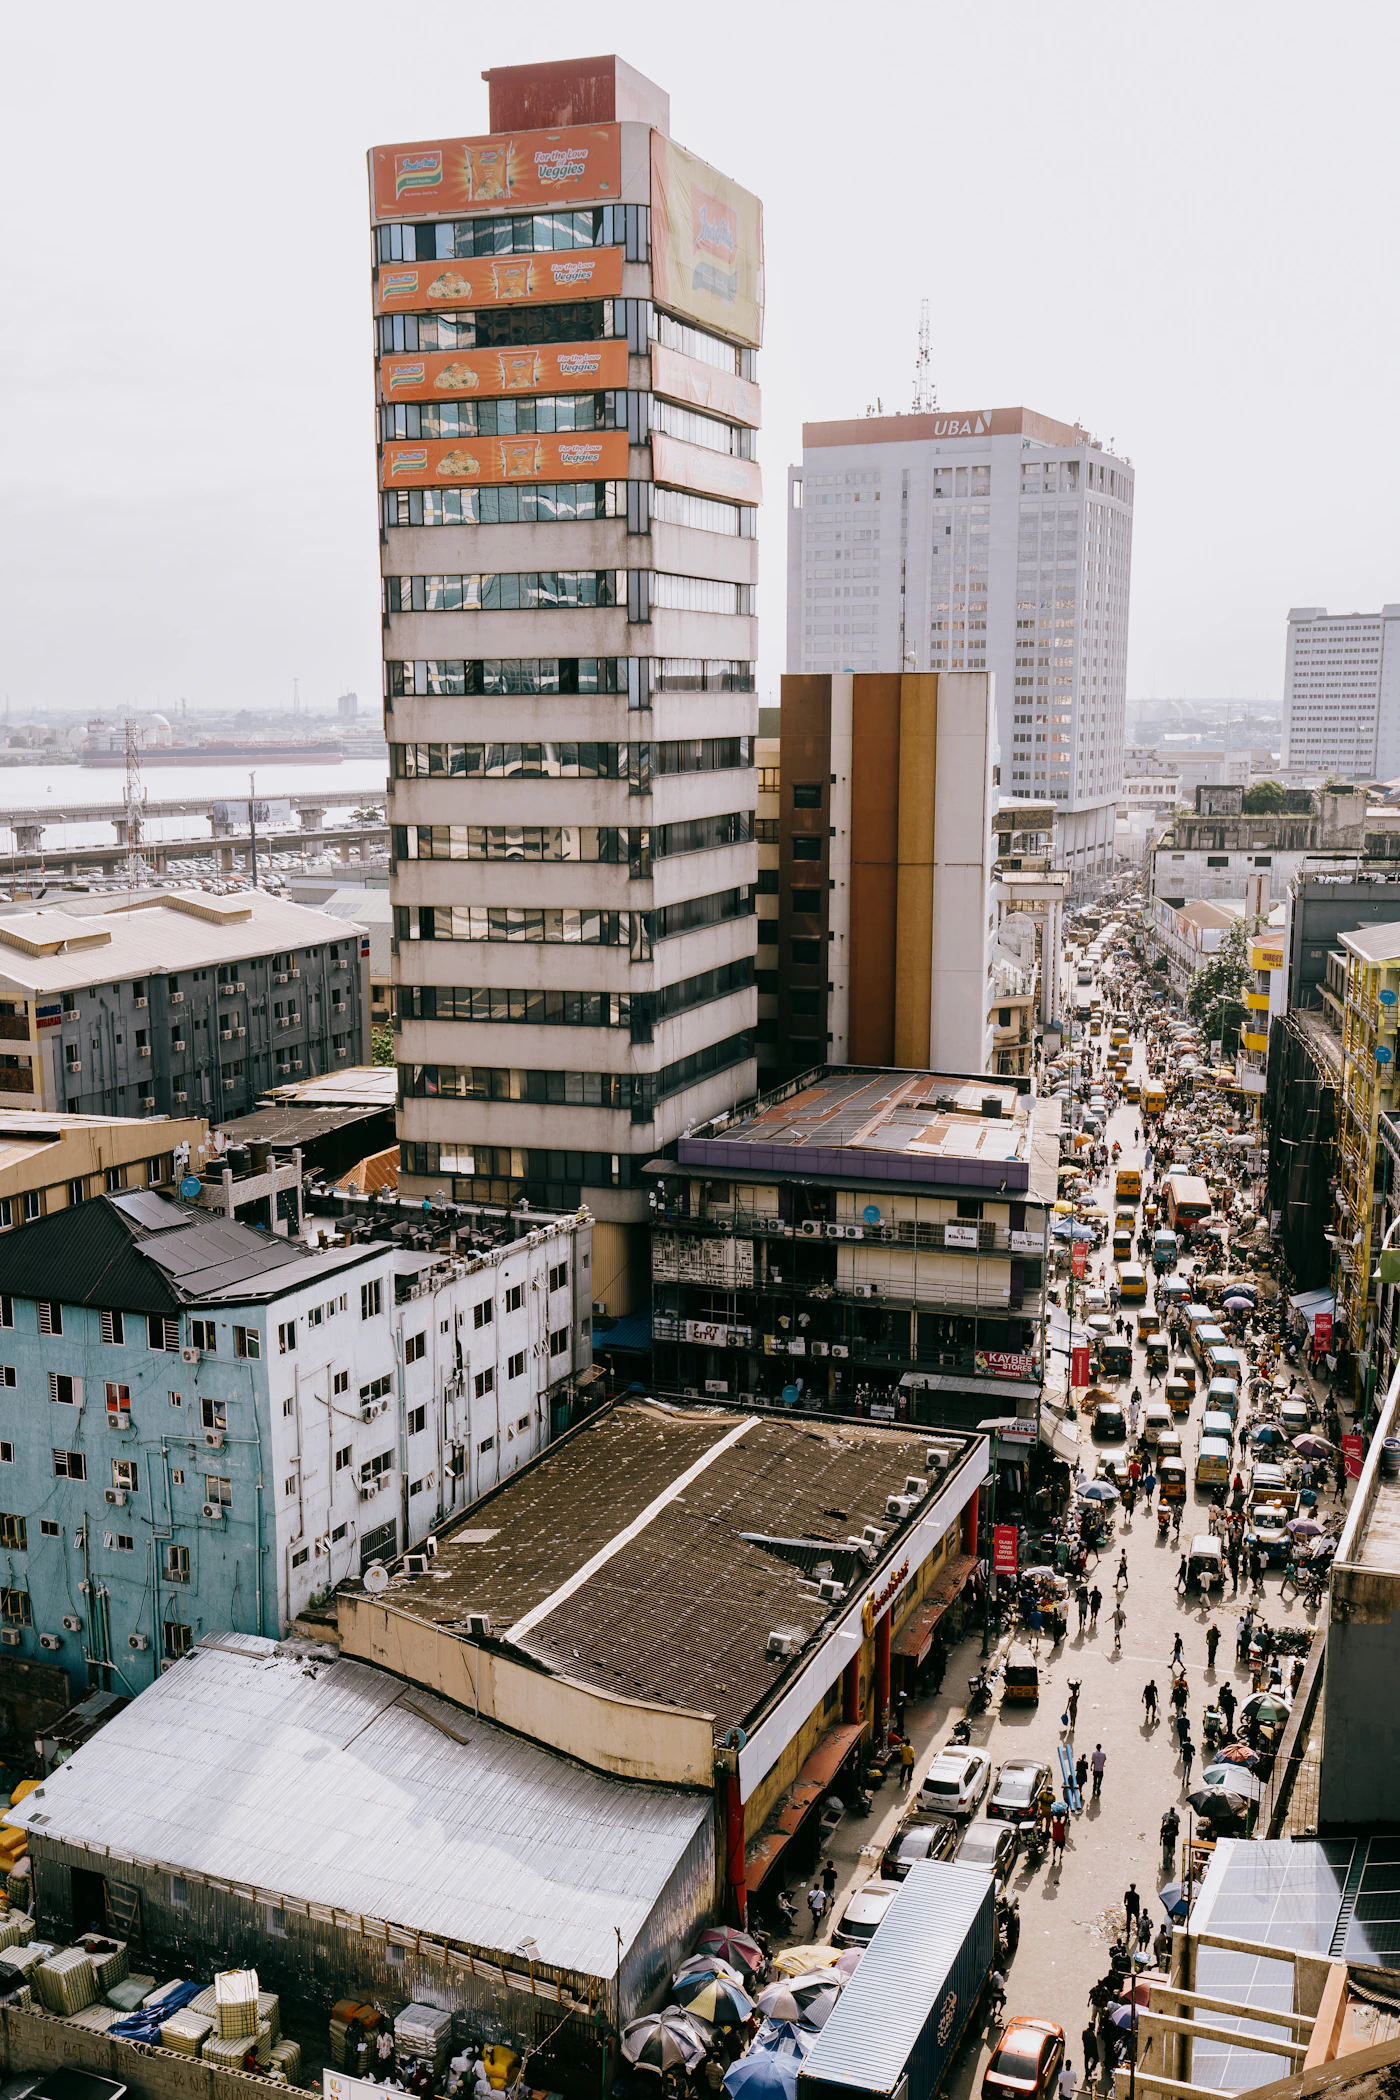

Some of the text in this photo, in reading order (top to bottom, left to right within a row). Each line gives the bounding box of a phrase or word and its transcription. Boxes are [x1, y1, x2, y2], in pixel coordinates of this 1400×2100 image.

[534, 147, 589, 163] For the Love
[538, 162, 585, 180] Veggies
[554, 270, 593, 282] Veggies
[560, 361, 599, 373] Veggies
[934, 419, 972, 436] UBA
[561, 452, 599, 464] Veggies
[989, 1353, 1033, 1366] KAYBEE
[1002, 1363, 1033, 1372] STORES
[44, 2035, 56, 2051] DO
